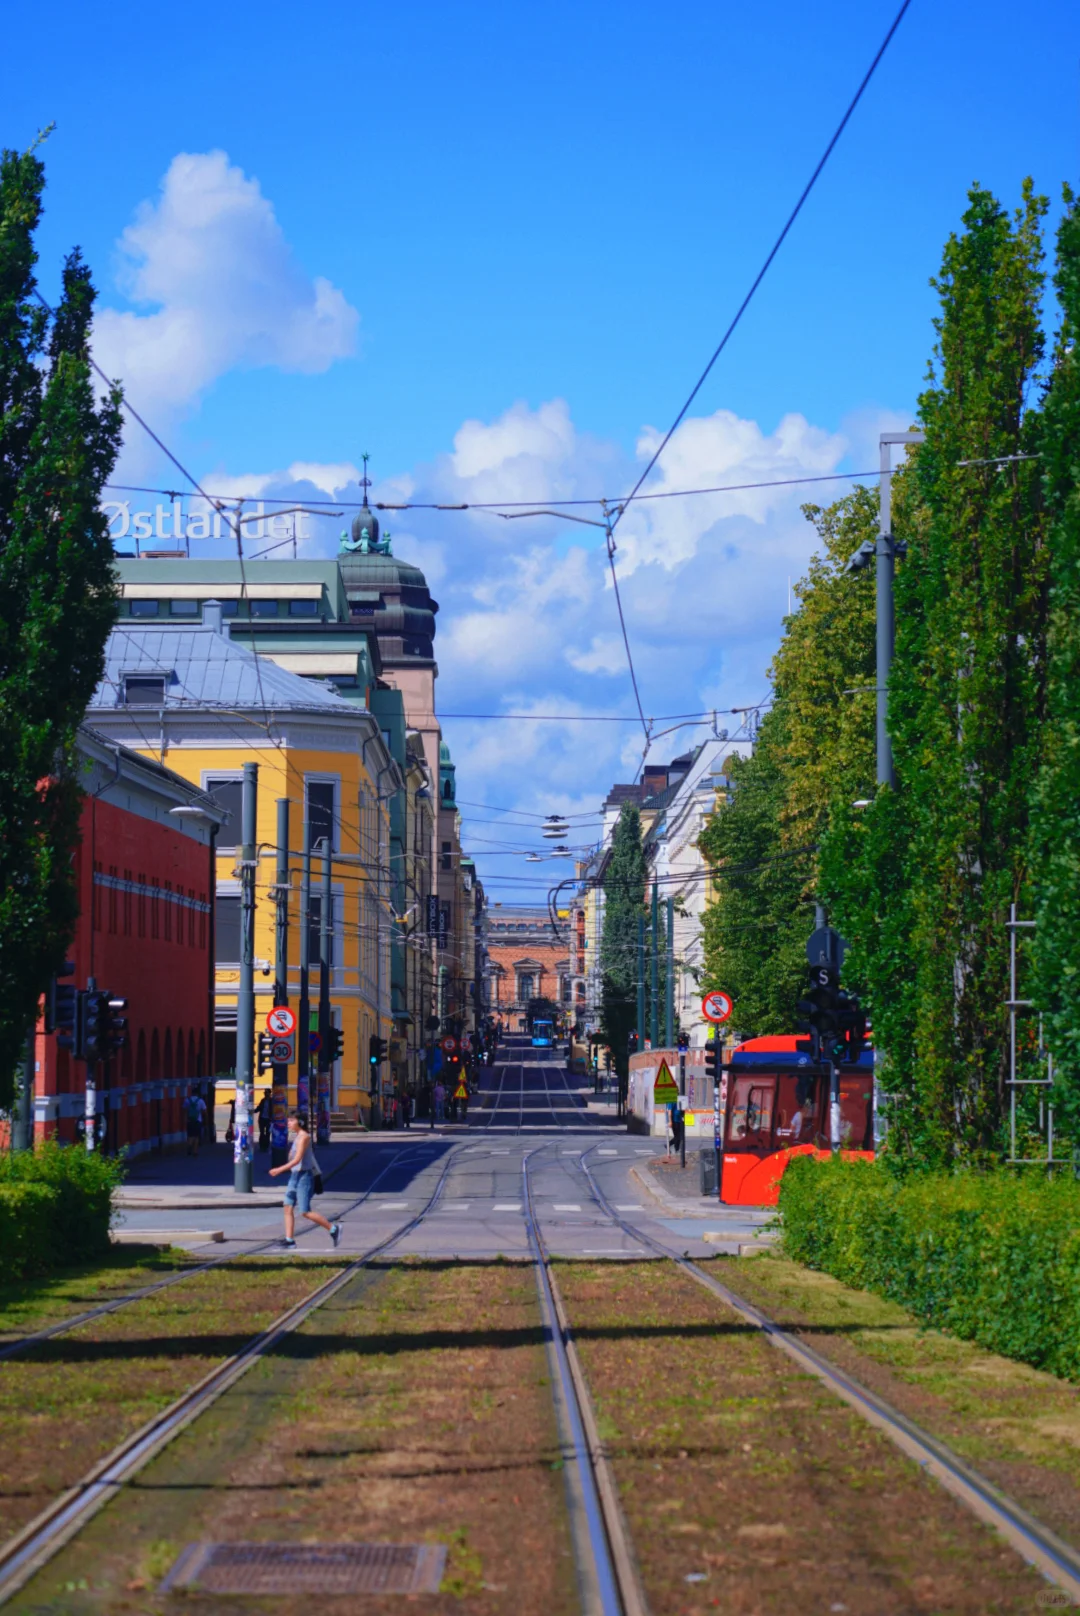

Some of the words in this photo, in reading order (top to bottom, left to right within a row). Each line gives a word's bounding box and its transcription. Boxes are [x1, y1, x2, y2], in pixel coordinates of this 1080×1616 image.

[99, 500, 310, 540] Østlandet
[429, 896, 437, 937] CITYBOX
[275, 1045, 288, 1057] 30
